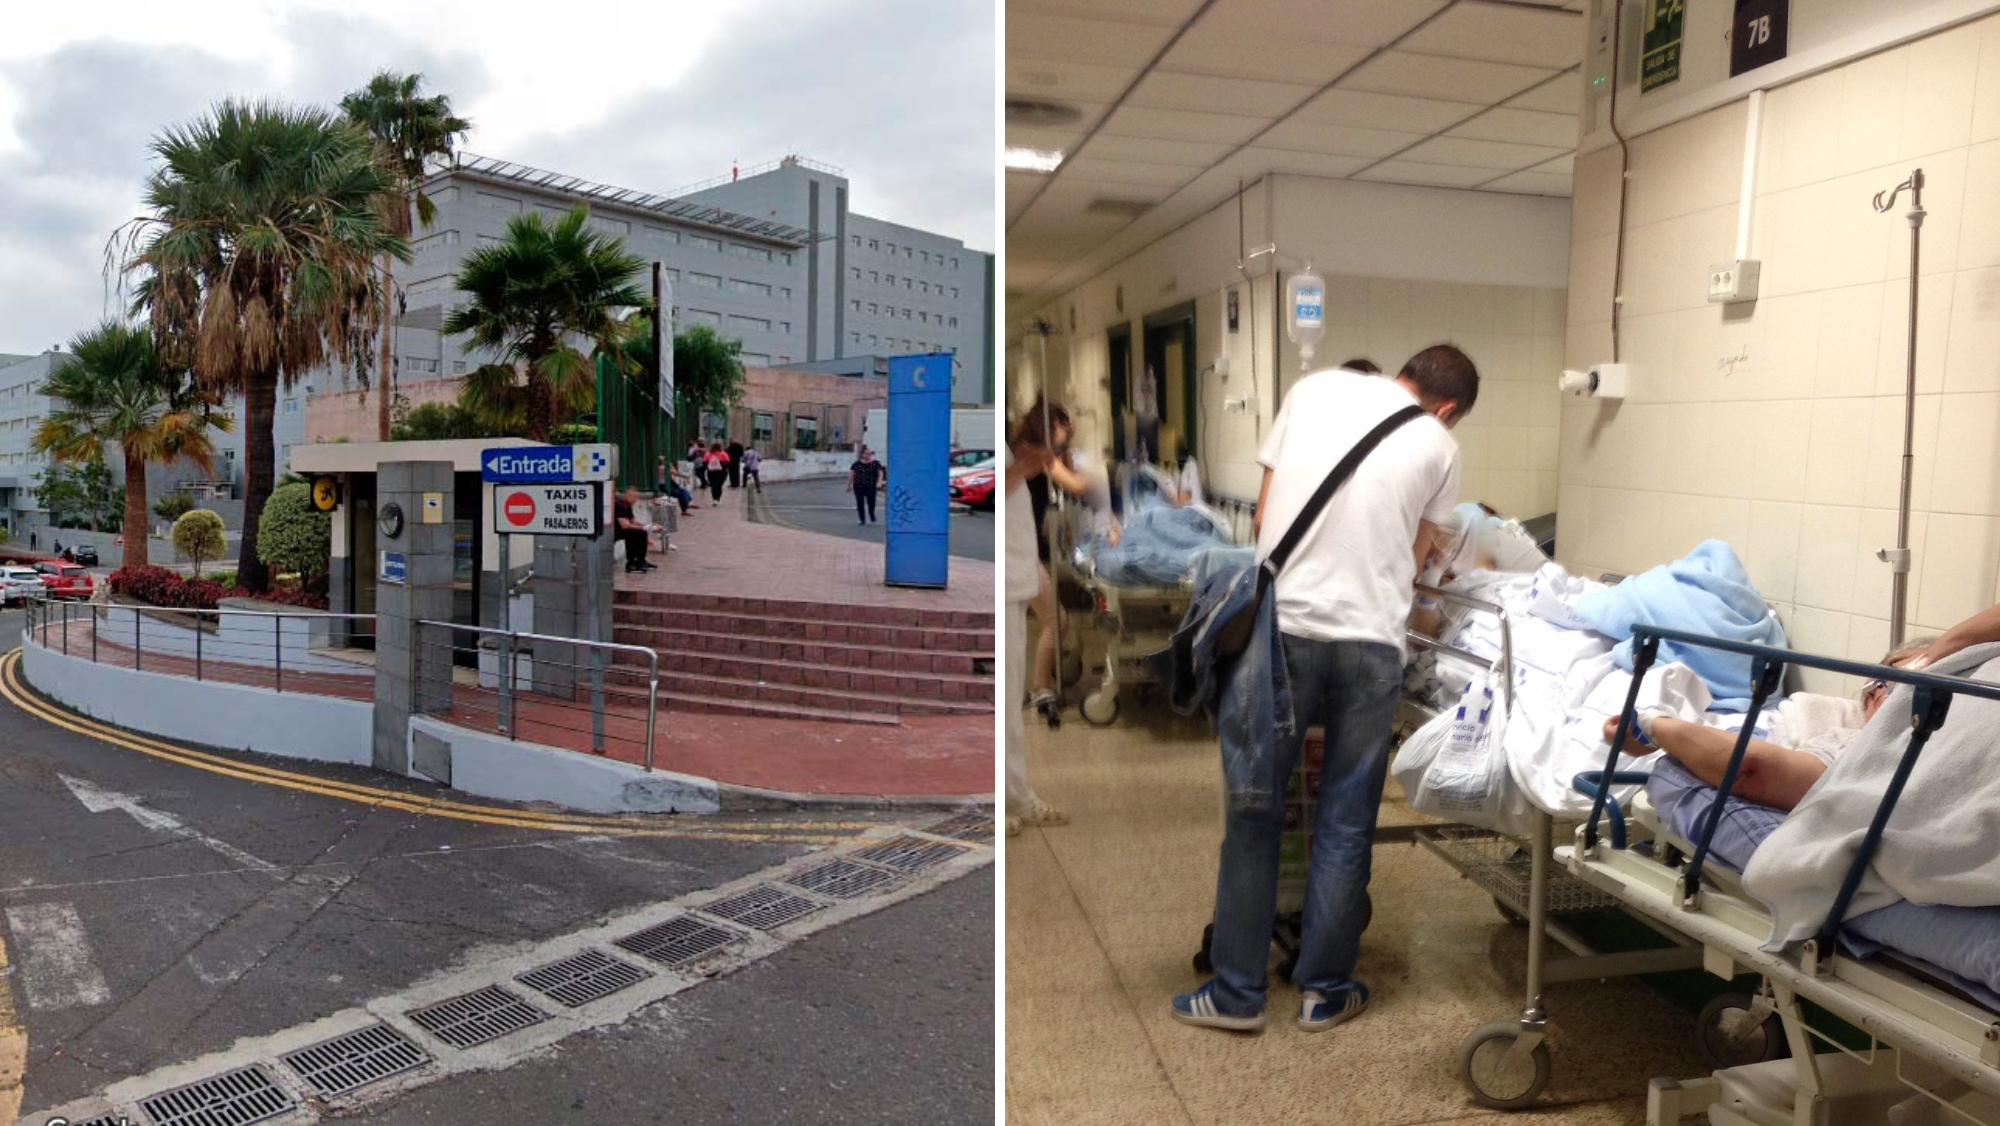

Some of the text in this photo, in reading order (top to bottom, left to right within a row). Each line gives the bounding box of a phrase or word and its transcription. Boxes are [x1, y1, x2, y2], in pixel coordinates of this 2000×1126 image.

[1748, 15, 1771, 49] 7B
[913, 366, 926, 387] C
[500, 454, 571, 474] Entrada
[544, 489, 587, 500] TAXIS
[555, 503, 578, 514] SIN
[544, 517, 589, 530] PASAJEROS
